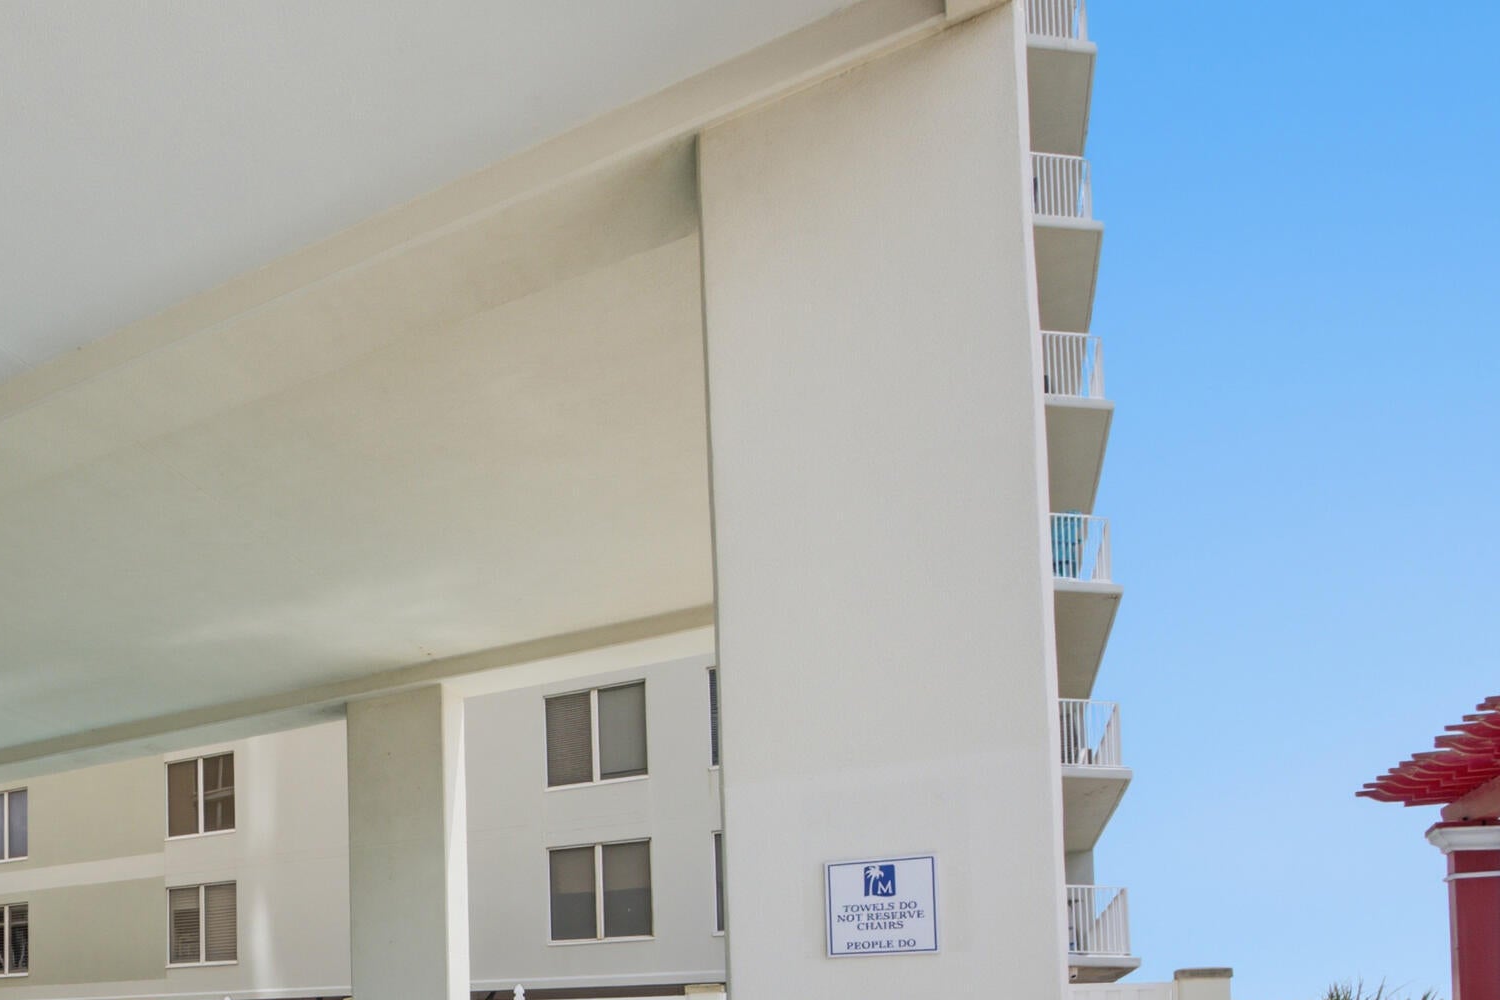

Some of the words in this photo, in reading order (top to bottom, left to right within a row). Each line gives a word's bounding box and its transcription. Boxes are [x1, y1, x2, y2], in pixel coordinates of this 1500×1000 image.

[876, 880, 893, 895] M
[842, 902, 895, 913] TOWELS
[899, 901, 918, 910] DO
[836, 913, 864, 923] NOT
[867, 910, 925, 921] RESERVE
[856, 920, 904, 931] CHAIRS
[846, 939, 895, 950] PEOPLE
[898, 938, 916, 948] DO
